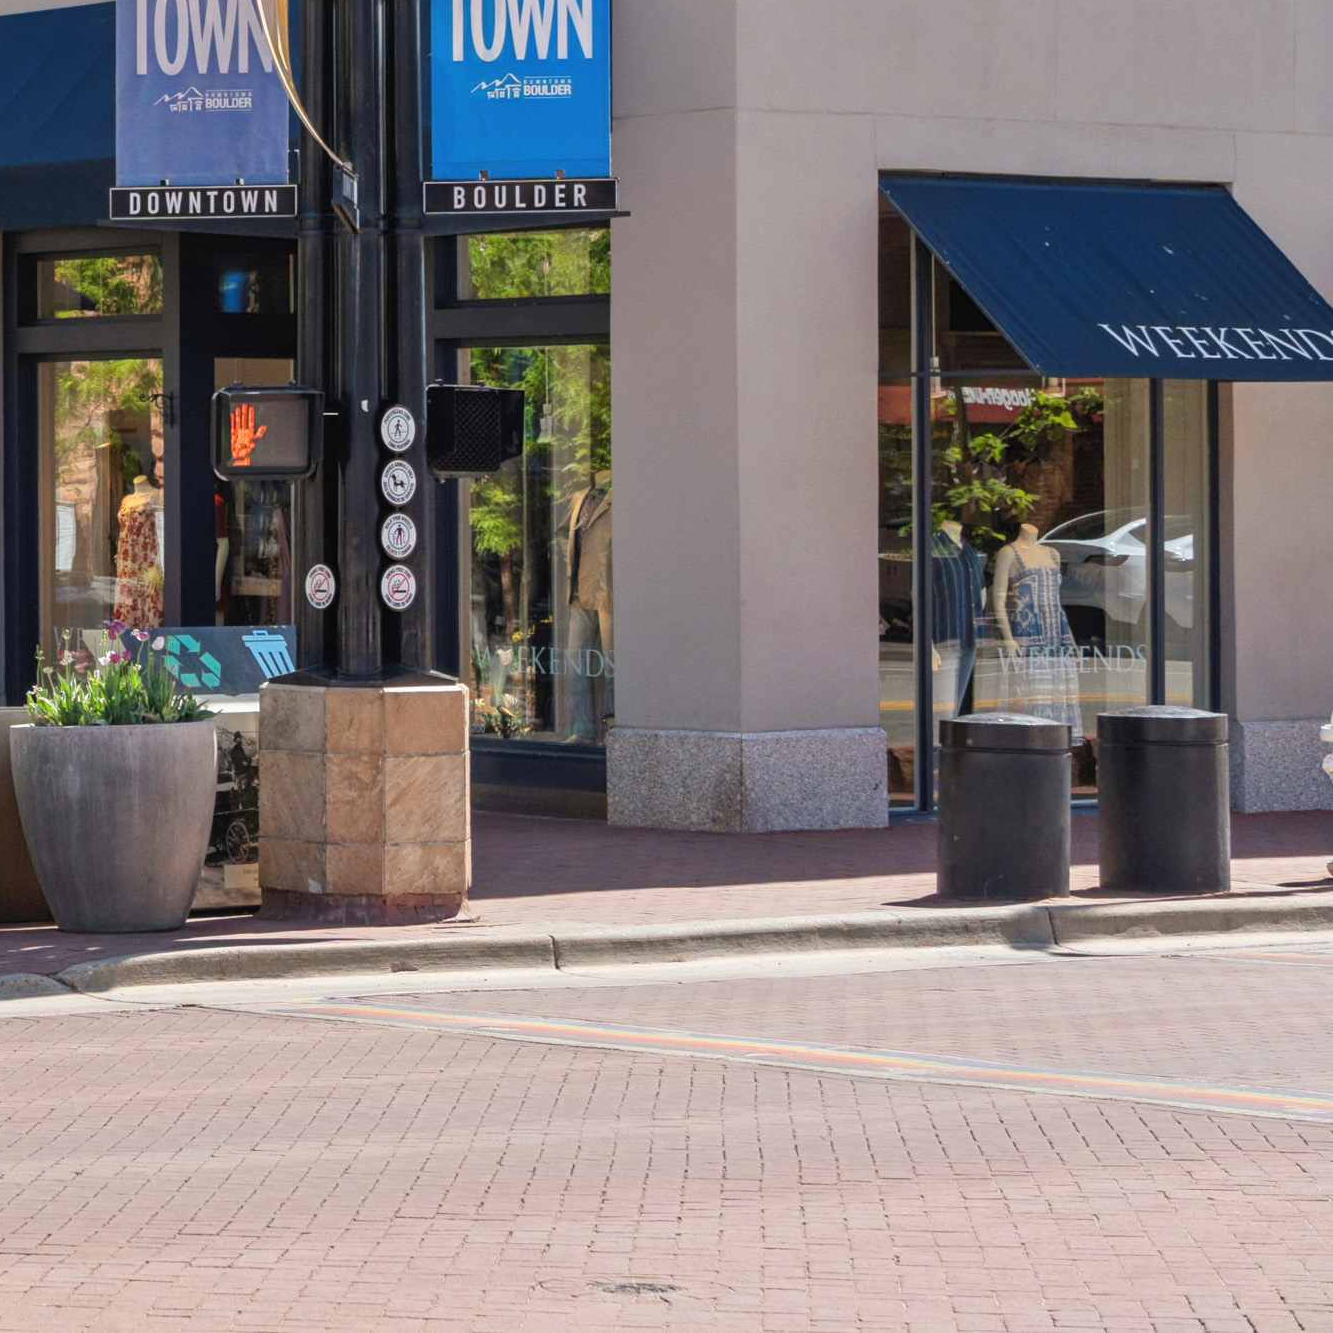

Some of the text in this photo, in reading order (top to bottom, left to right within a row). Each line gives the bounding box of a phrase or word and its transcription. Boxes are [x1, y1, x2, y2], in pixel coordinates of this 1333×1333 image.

[205, 97, 253, 109] BOULDER
[523, 85, 571, 97] BOULDER
[129, 189, 279, 215] DOWNTOWN
[453, 184, 588, 209] BOULDER
[1098, 324, 1333, 361] WEEKEND
[997, 644, 1147, 675] WEEKENDS
